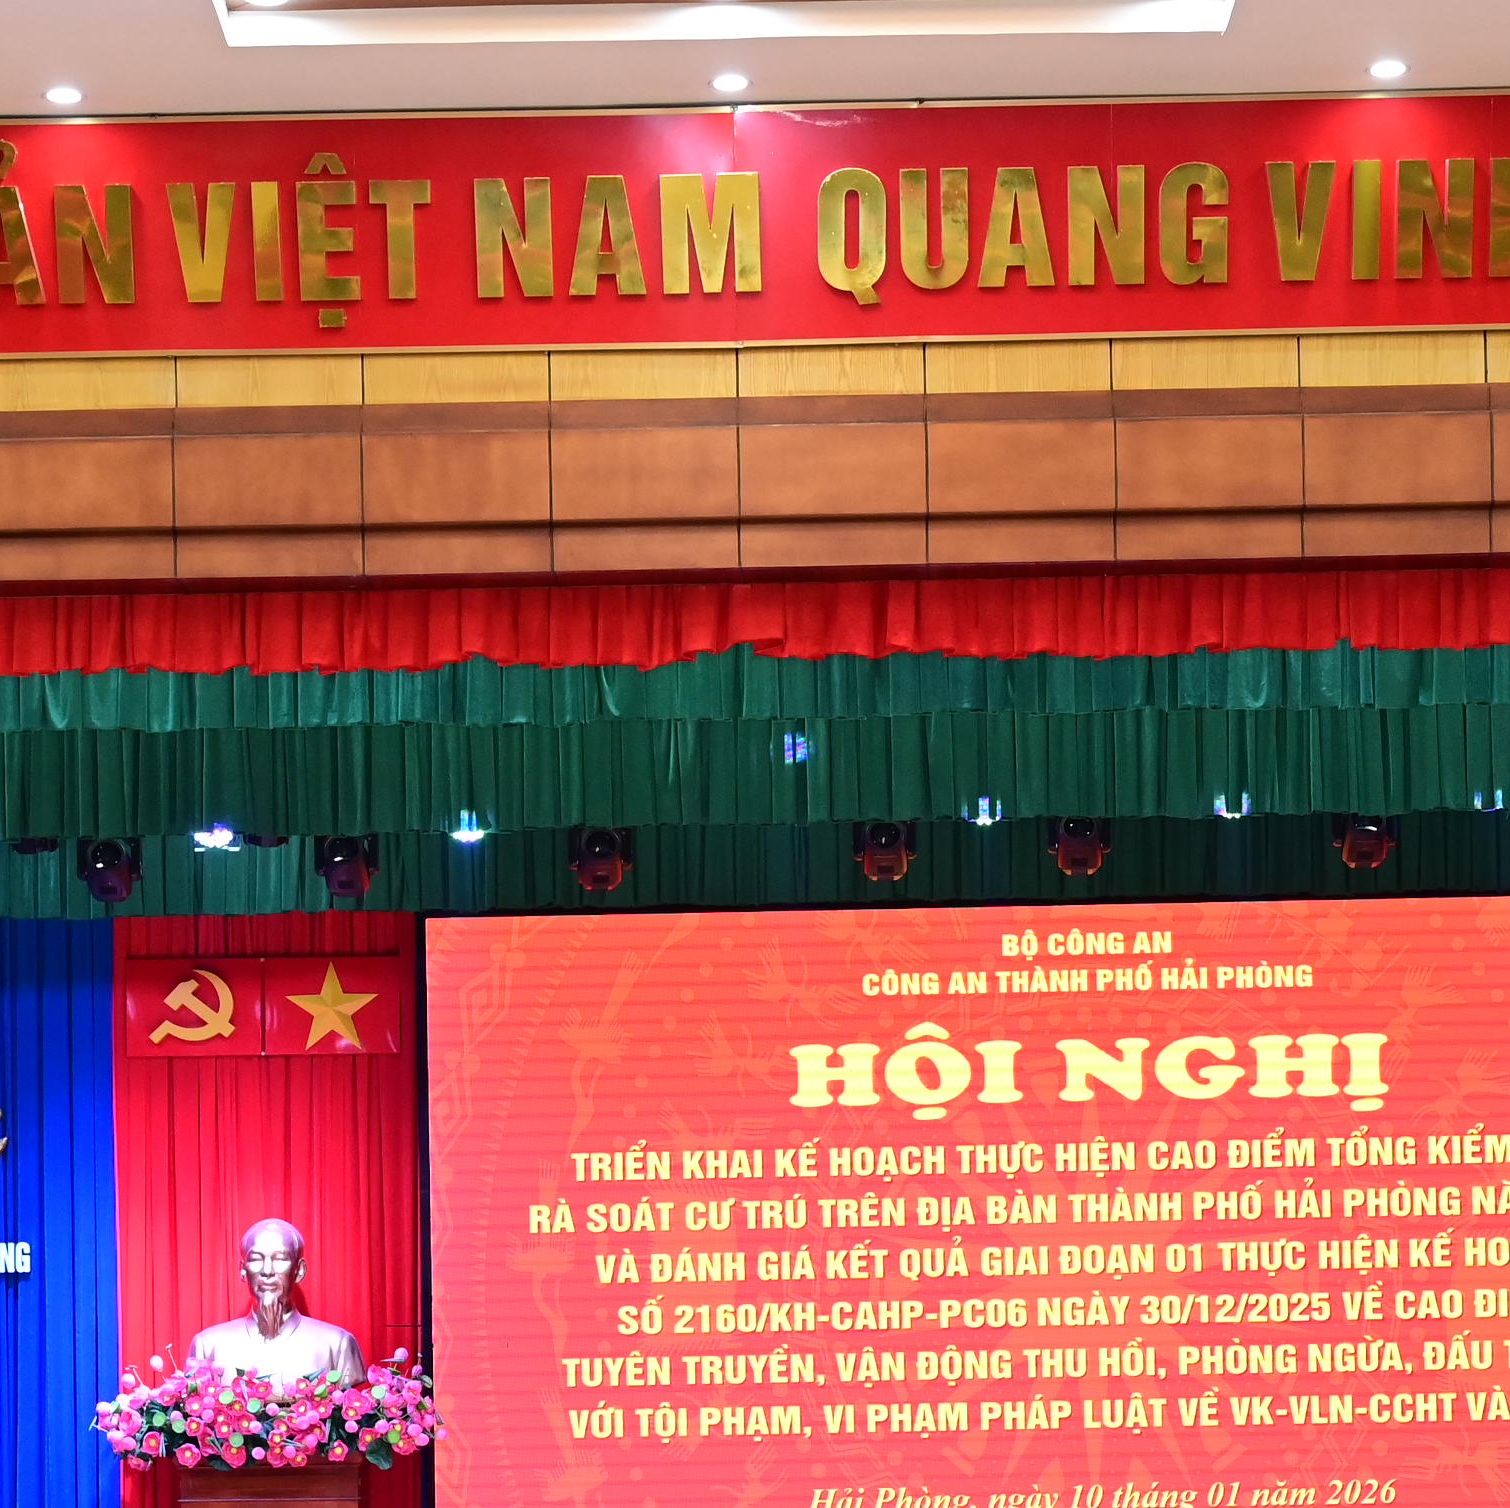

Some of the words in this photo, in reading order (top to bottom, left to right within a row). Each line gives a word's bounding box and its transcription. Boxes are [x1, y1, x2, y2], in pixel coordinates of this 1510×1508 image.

[163, 153, 431, 330] VIỆT
[472, 170, 764, 299] NAM
[815, 161, 1231, 306] QUANG
[1001, 928, 1039, 961] BỘ
[1047, 928, 1125, 956] CÔNG
[1132, 930, 1172, 955] AN
[861, 968, 940, 997] CÔNG
[947, 971, 988, 995] AN
[994, 965, 1089, 994] THÀNH
[1095, 963, 1153, 992] PHỐ
[1160, 962, 1208, 990] HẢI
[1216, 960, 1313, 989] PHÒNG
[788, 1021, 1024, 1121] HỘI
[1055, 1032, 1390, 1112] NGHỊ
[570, 1139, 671, 1182] TRIỂN
[682, 1149, 763, 1180] KHAI
[774, 1137, 821, 1178] KẾ
[829, 1145, 945, 1182] HOẠCH
[955, 1140, 1044, 1179] THỰC
[1055, 1135, 1136, 1178] HIỆN
[1147, 1139, 1216, 1171] CAO
[1226, 1127, 1316, 1169] ĐIỂM
[1325, 1126, 1416, 1167] TỔNG
[617, 1294, 664, 1335] SỐ
[673, 1297, 1028, 1334] 2160/KH-CAHP-PC06
[1036, 1289, 1131, 1327] NGÀY
[1139, 1292, 1331, 1325] 30/12/2025
[1341, 1280, 1383, 1321] VỀ
[1394, 1288, 1463, 1320] CAO
[1207, 1481, 1240, 1507] 01
[1250, 1479, 1316, 1507] năm
[1324, 1478, 1397, 1505] 2026
